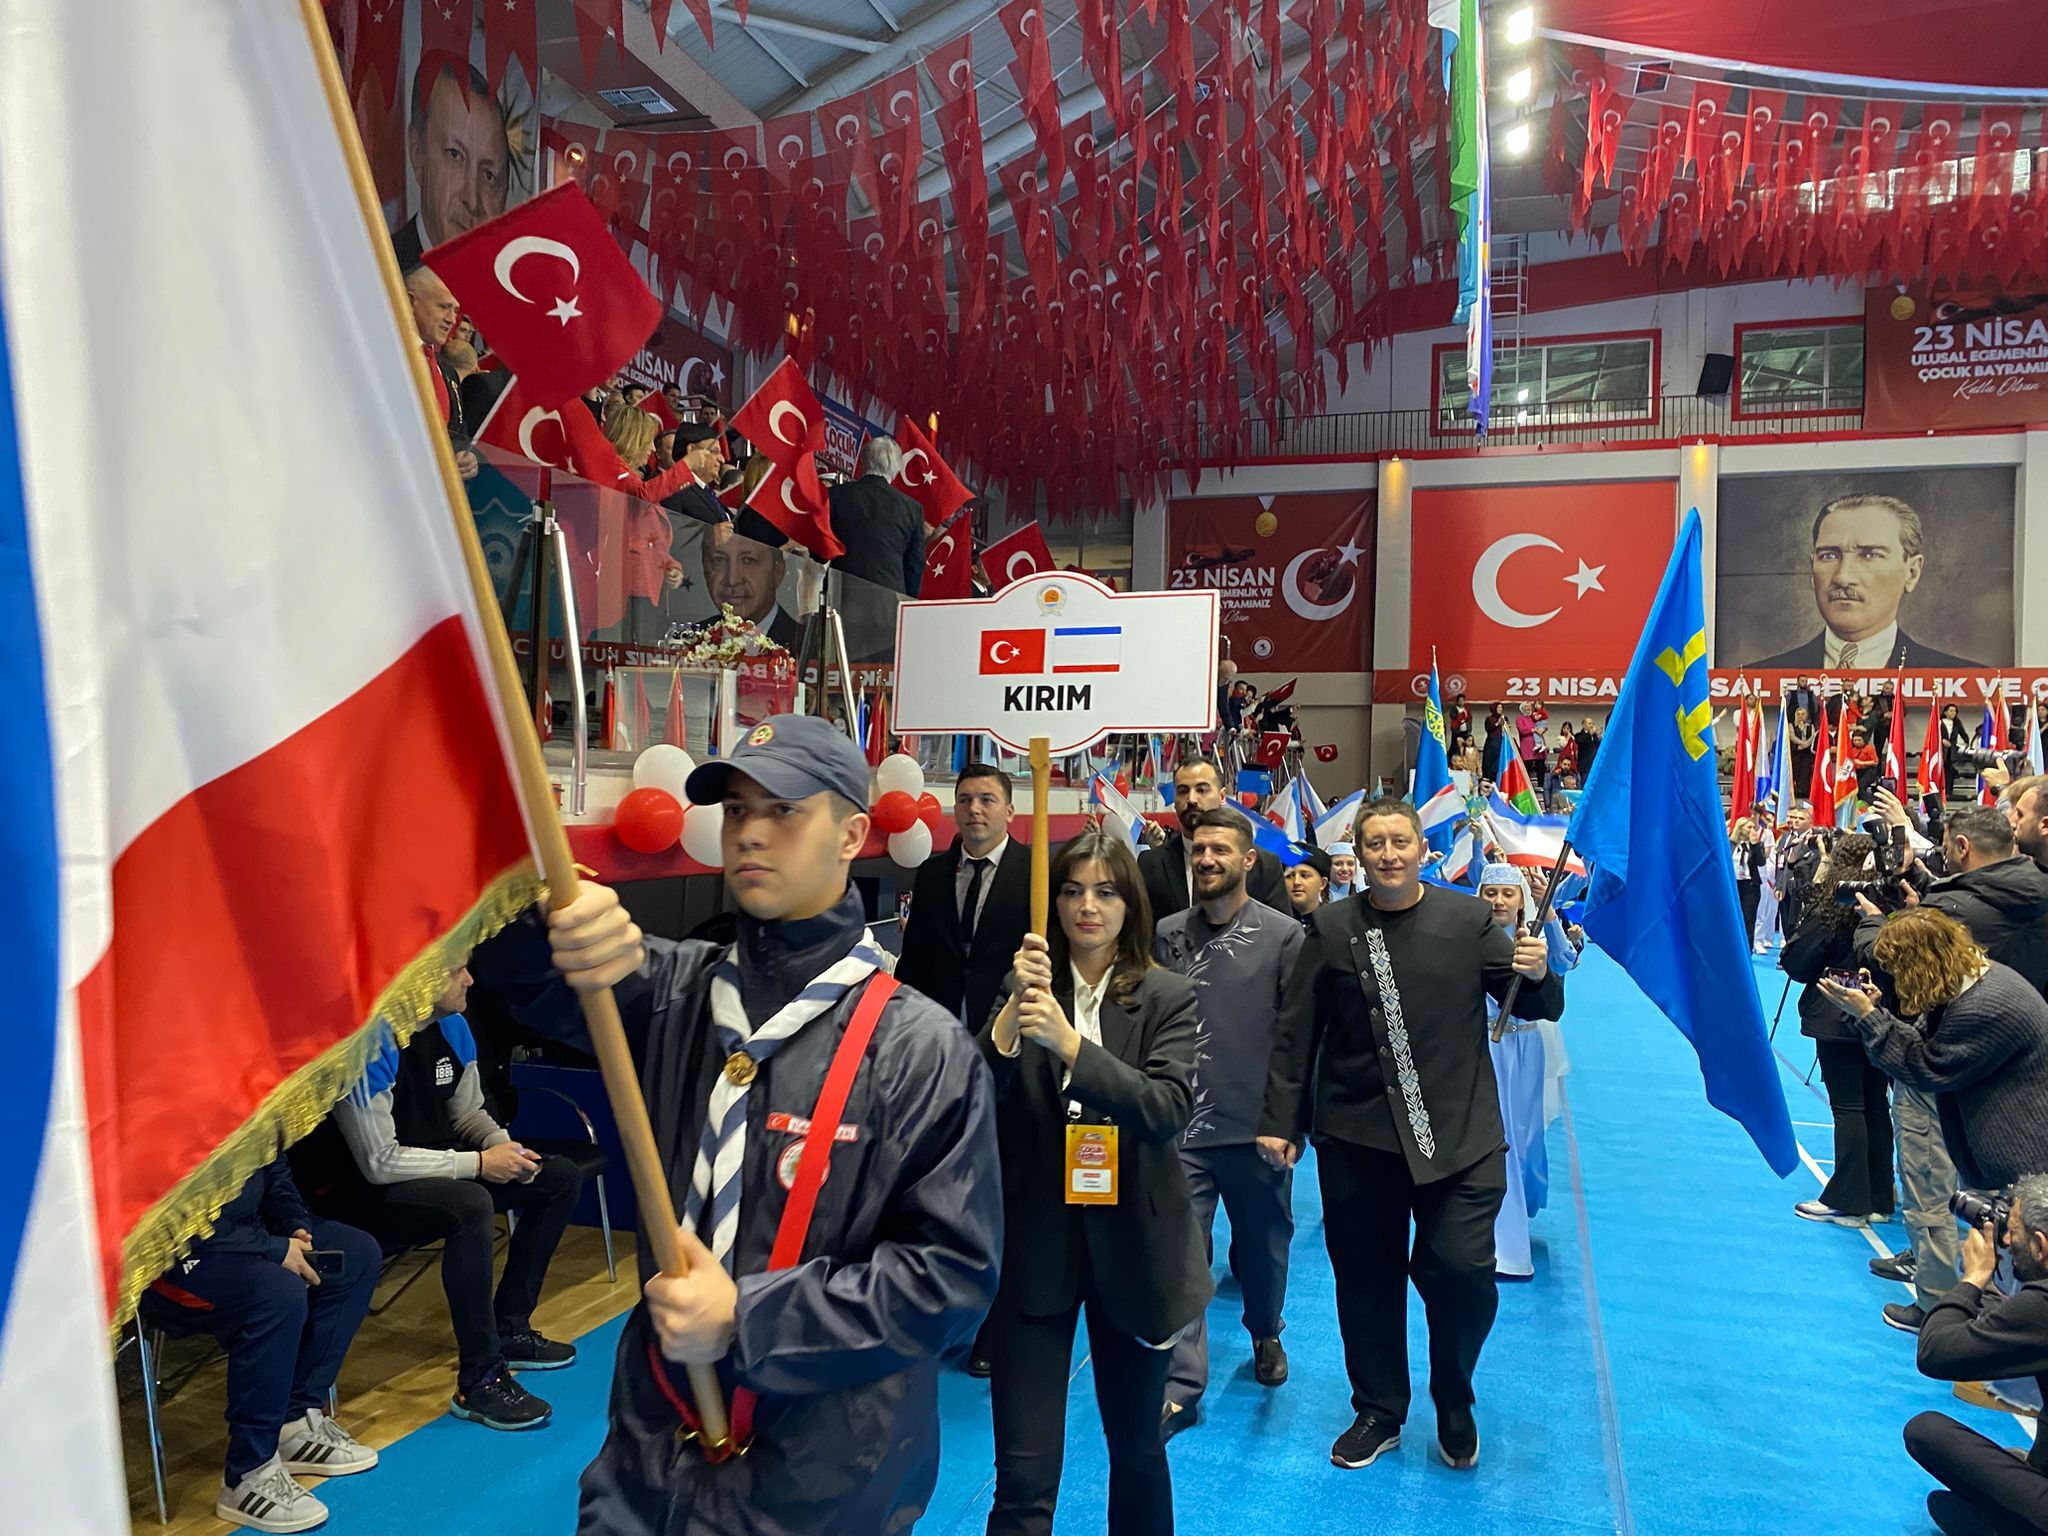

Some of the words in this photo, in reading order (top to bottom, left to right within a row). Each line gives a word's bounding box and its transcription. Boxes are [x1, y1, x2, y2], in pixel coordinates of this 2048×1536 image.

[1912, 325, 1955, 351] 23
[1911, 352, 1967, 366] ULUSAL
[1918, 366, 1972, 383] ÇOCUK
[1952, 378, 1996, 400] Kutlu
[1996, 376, 2040, 396] Olsun
[1171, 569, 1198, 588] 23
[1203, 564, 1275, 587] NİSAN
[1220, 587, 1258, 598] EMENLİK
[1260, 588, 1273, 598] VE
[1219, 599, 1271, 609] YRAMIMIZ
[1004, 684, 1091, 712] KIRIM
[1506, 677, 1541, 697] 23
[1549, 677, 1625, 697] NİSA
[1710, 677, 1771, 698] SAL
[1976, 677, 2022, 698] VE
